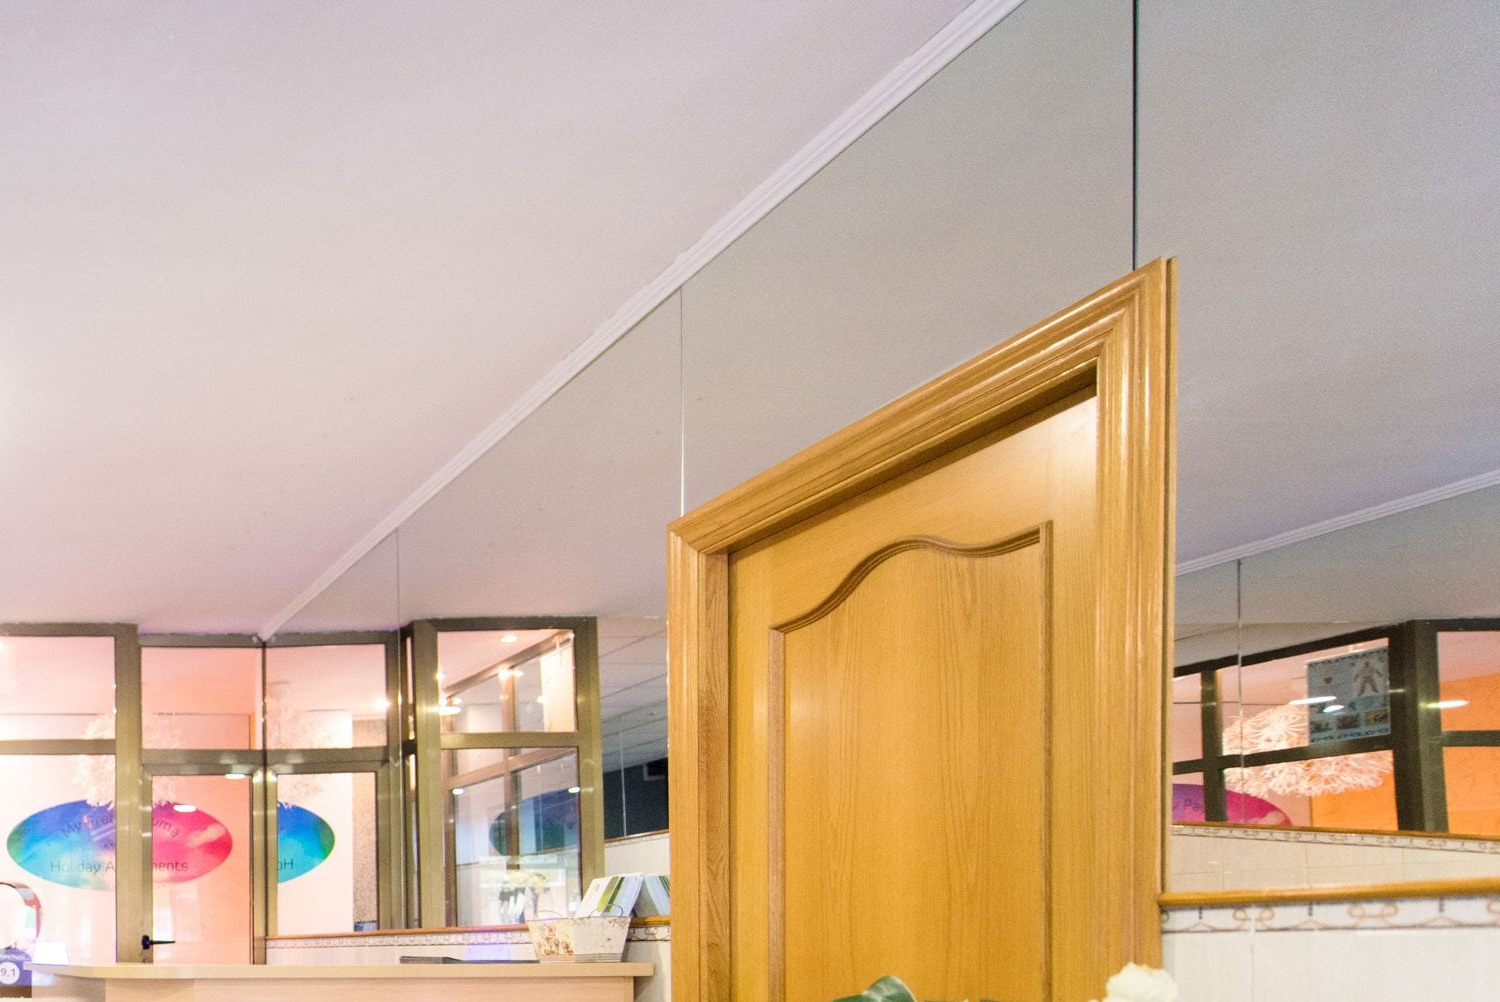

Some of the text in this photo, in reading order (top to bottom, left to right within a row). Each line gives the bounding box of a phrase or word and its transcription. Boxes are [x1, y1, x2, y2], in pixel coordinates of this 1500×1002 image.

[61, 821, 82, 838] My
[50, 860, 101, 876] Holiday
[0, 967, 16, 978] 9.1
